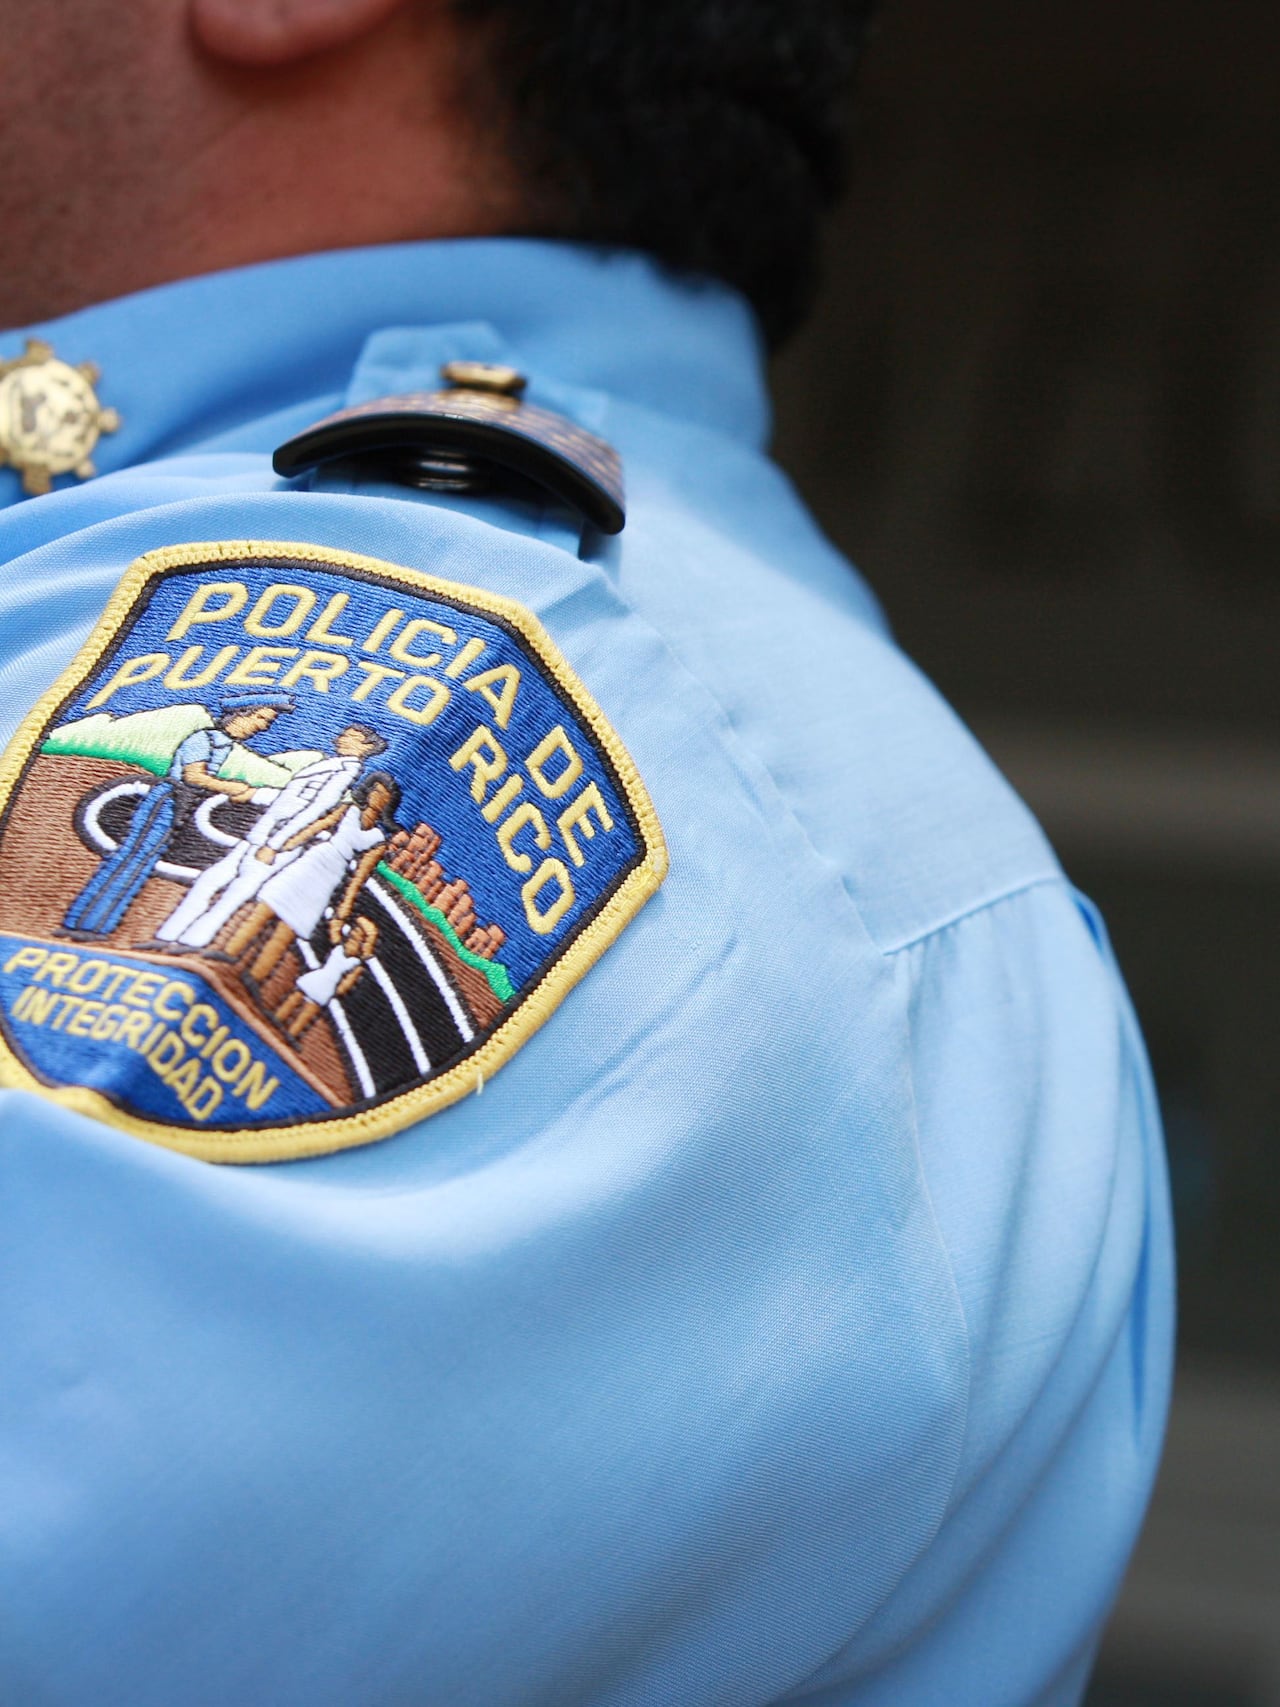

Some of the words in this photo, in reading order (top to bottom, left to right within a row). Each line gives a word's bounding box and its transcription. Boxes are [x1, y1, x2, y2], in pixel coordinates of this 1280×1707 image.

[87, 645, 450, 726] PUERTO
[448, 726, 575, 936] RICO
[166, 581, 519, 728] POLICIA
[524, 726, 615, 866] DE
[4, 947, 279, 1110] PROTECCION
[11, 986, 223, 1120] INTEGRIDAD
